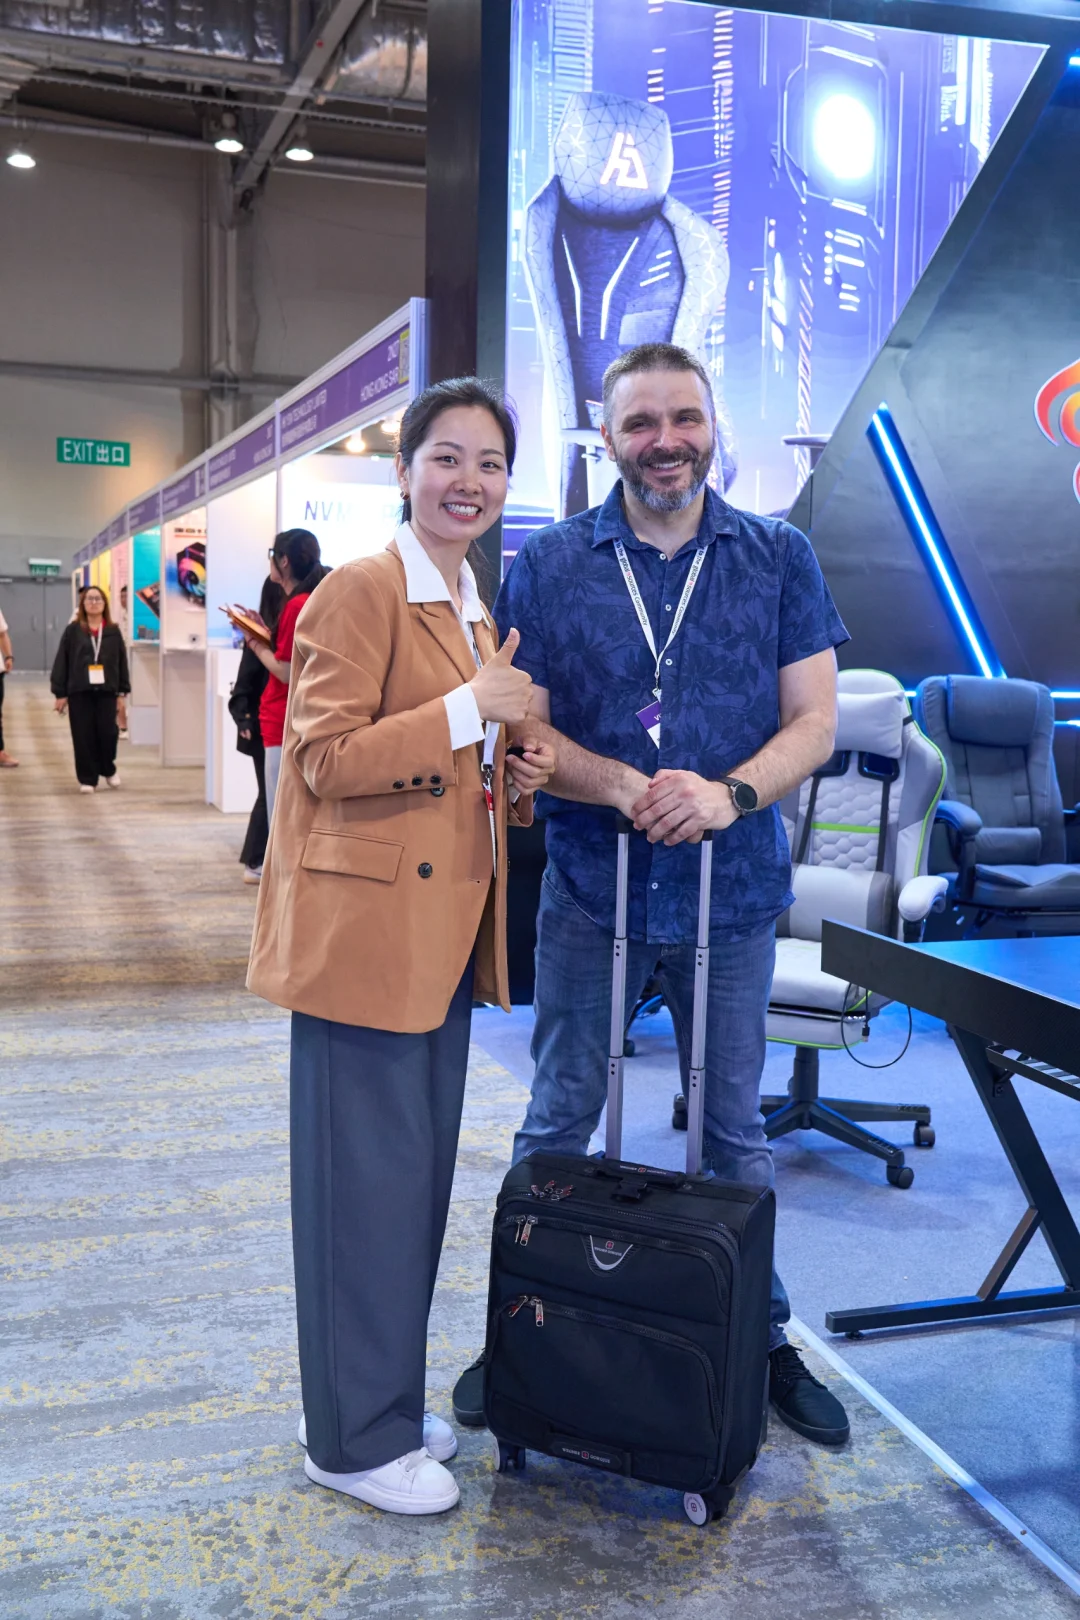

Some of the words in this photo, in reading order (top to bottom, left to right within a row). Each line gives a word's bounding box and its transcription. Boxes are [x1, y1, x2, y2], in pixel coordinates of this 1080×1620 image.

[63, 440, 94, 462] EXIT
[96, 443, 125, 463] 出口
[619, 557, 630, 573] global
[626, 575, 638, 596] sources
[634, 596, 648, 626] Community
